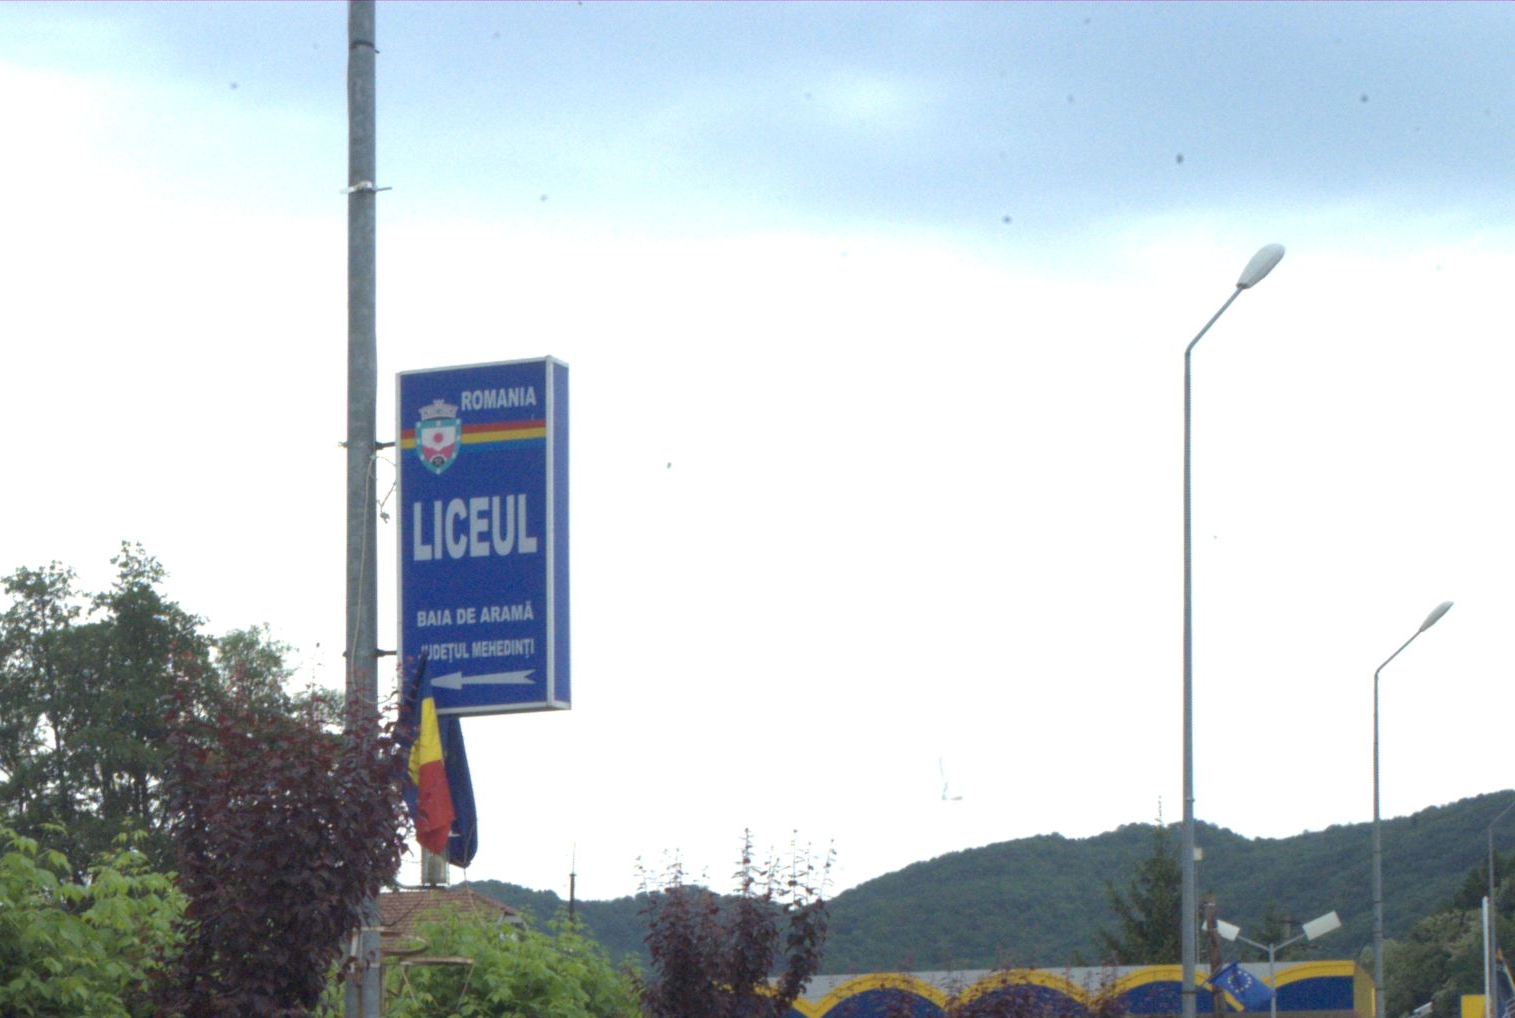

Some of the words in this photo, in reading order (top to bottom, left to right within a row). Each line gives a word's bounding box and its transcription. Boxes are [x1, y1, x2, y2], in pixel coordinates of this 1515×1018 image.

[461, 387, 536, 411] ROMANIA
[413, 494, 537, 561] LICEUL
[417, 609, 452, 627] BAIA
[456, 607, 476, 624] DE
